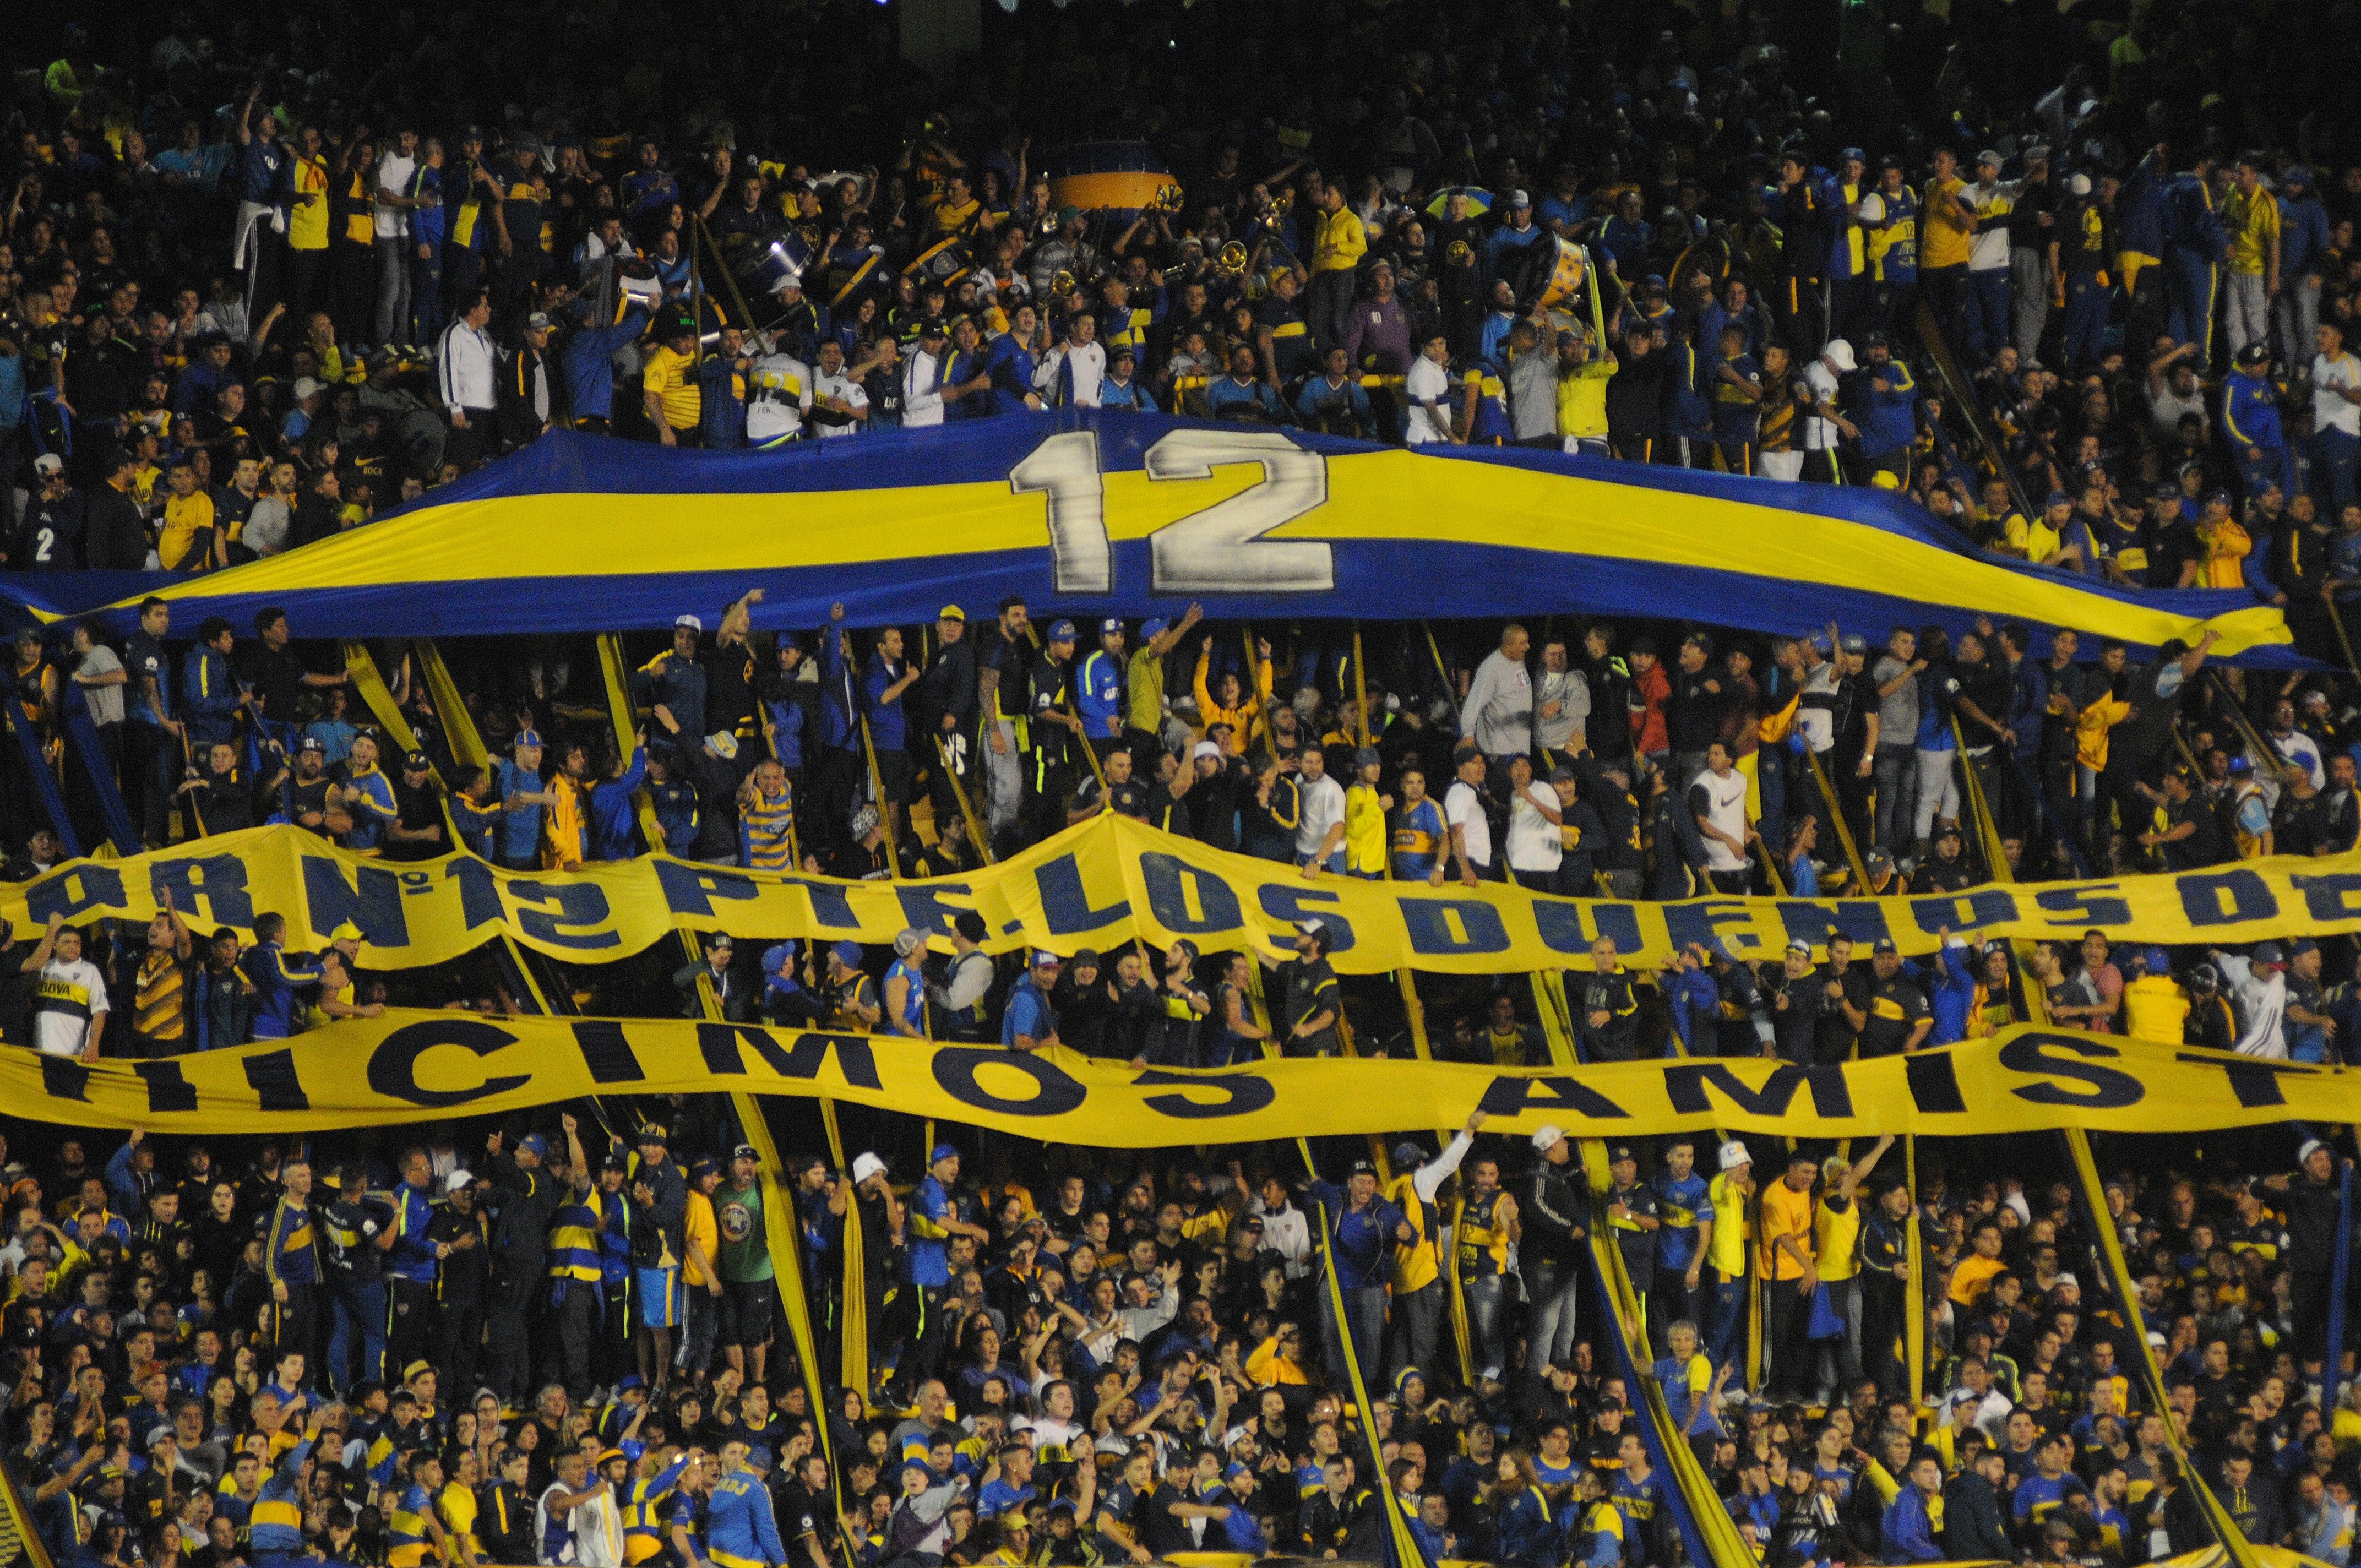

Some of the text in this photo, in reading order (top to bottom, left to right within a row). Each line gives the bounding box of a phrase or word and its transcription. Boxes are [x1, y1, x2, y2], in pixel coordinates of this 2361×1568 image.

[1009, 429, 1334, 593] 12
[304, 737, 315, 748] 12
[1035, 852, 1357, 952] LOS
[40, 983, 70, 995] BBVA
[1476, 1032, 2344, 1118] AMIST
